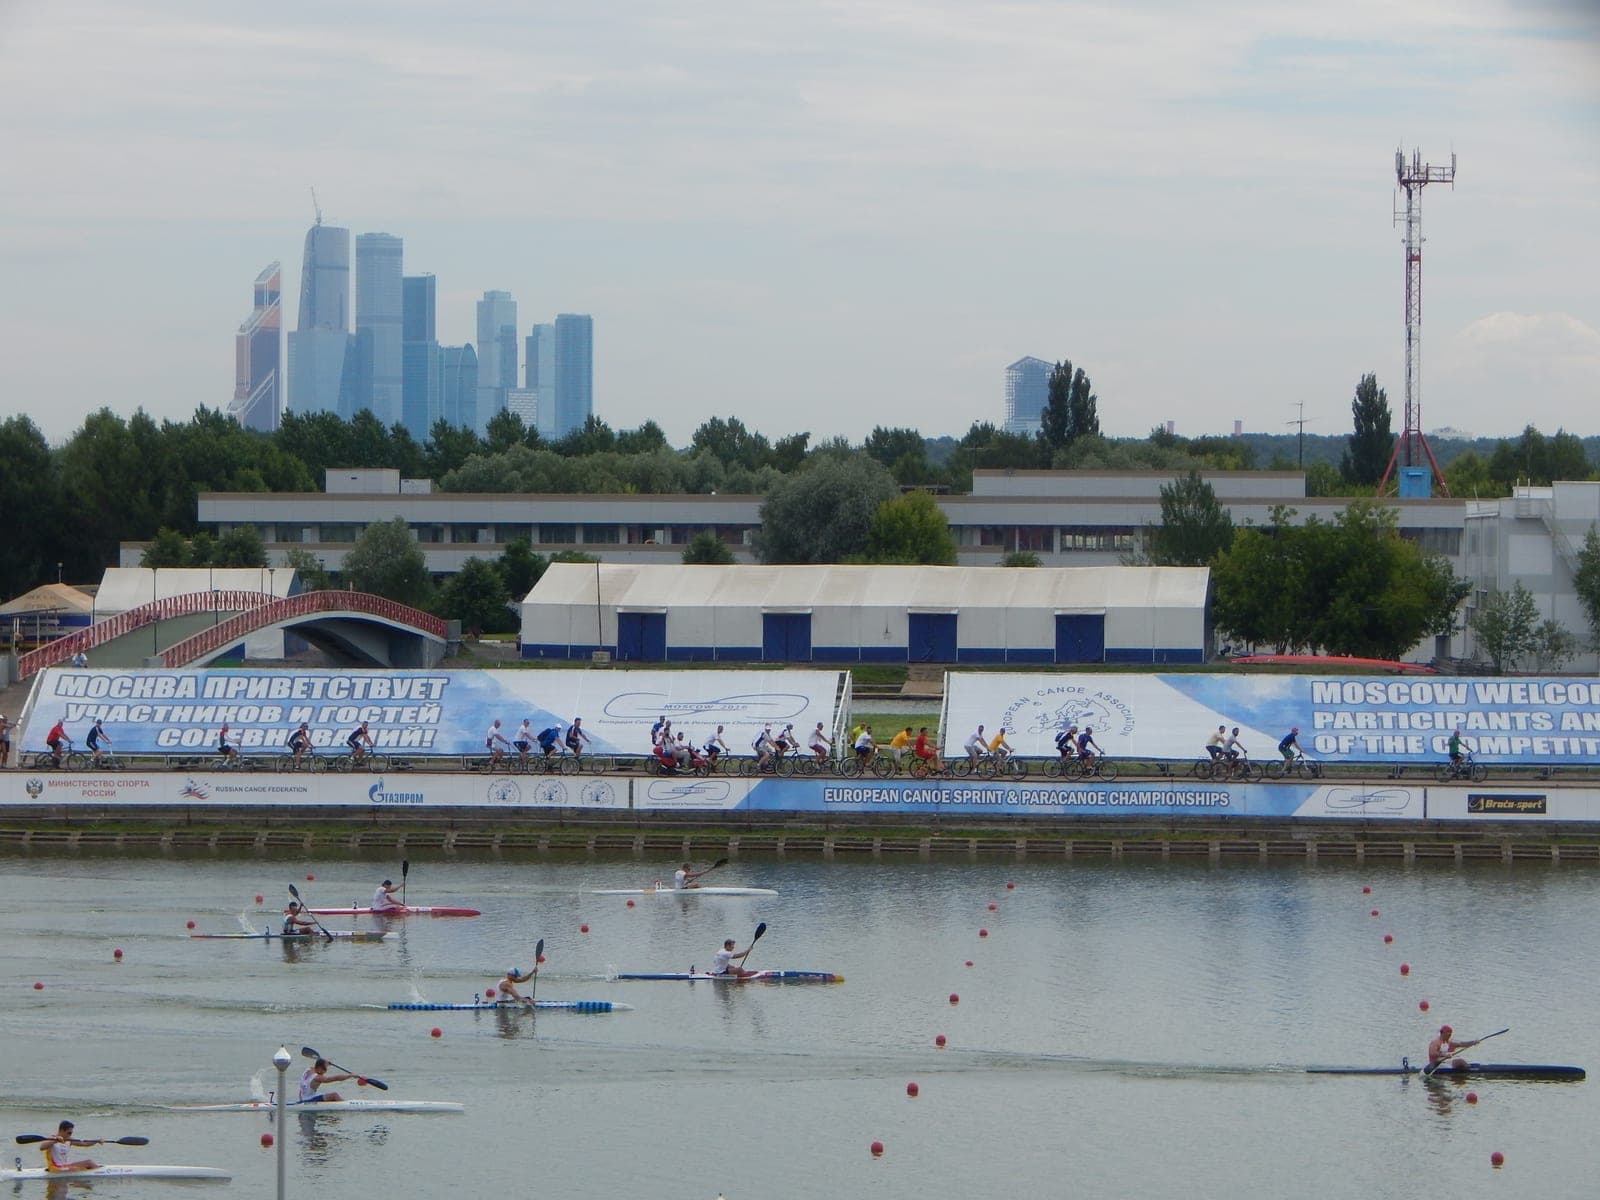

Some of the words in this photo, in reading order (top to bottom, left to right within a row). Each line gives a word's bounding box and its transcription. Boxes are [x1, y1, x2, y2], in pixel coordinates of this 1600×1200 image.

[55, 674, 198, 699] МОСКВА
[202, 675, 450, 700] ПРИВЕТСТВУЕТ
[1311, 681, 1468, 705] MOSCOW
[64, 703, 283, 724] УЧАСТНИКОВ
[287, 704, 314, 724] И
[316, 702, 442, 725] ГОСТЕЙ
[1002, 696, 1031, 736] EUROPEAN
[1036, 686, 1086, 697] CANOE
[1093, 690, 1136, 737] ASSOCIATION
[1313, 710, 1555, 731] PARTICIPANTS
[157, 726, 437, 749] СОРЕВНВАНИЙ!
[1314, 735, 1357, 754] OF
[1360, 735, 1426, 754] THE
[48, 779, 115, 788] МИНИСТЕРСТВО
[117, 780, 150, 788] СПОРТА
[81, 790, 116, 798] РОССИИ
[385, 793, 424, 804] ГАЗПРОМ
[824, 788, 899, 803] EUROPEAN
[902, 788, 950, 803] CANOE
[953, 789, 1004, 804] SPRINT
[1006, 789, 1018, 804] &
[1020, 790, 1106, 805] PARACANOE
[1109, 791, 1230, 807] CHAMPIONSHIPS
[268, 1091, 275, 1103] 7
